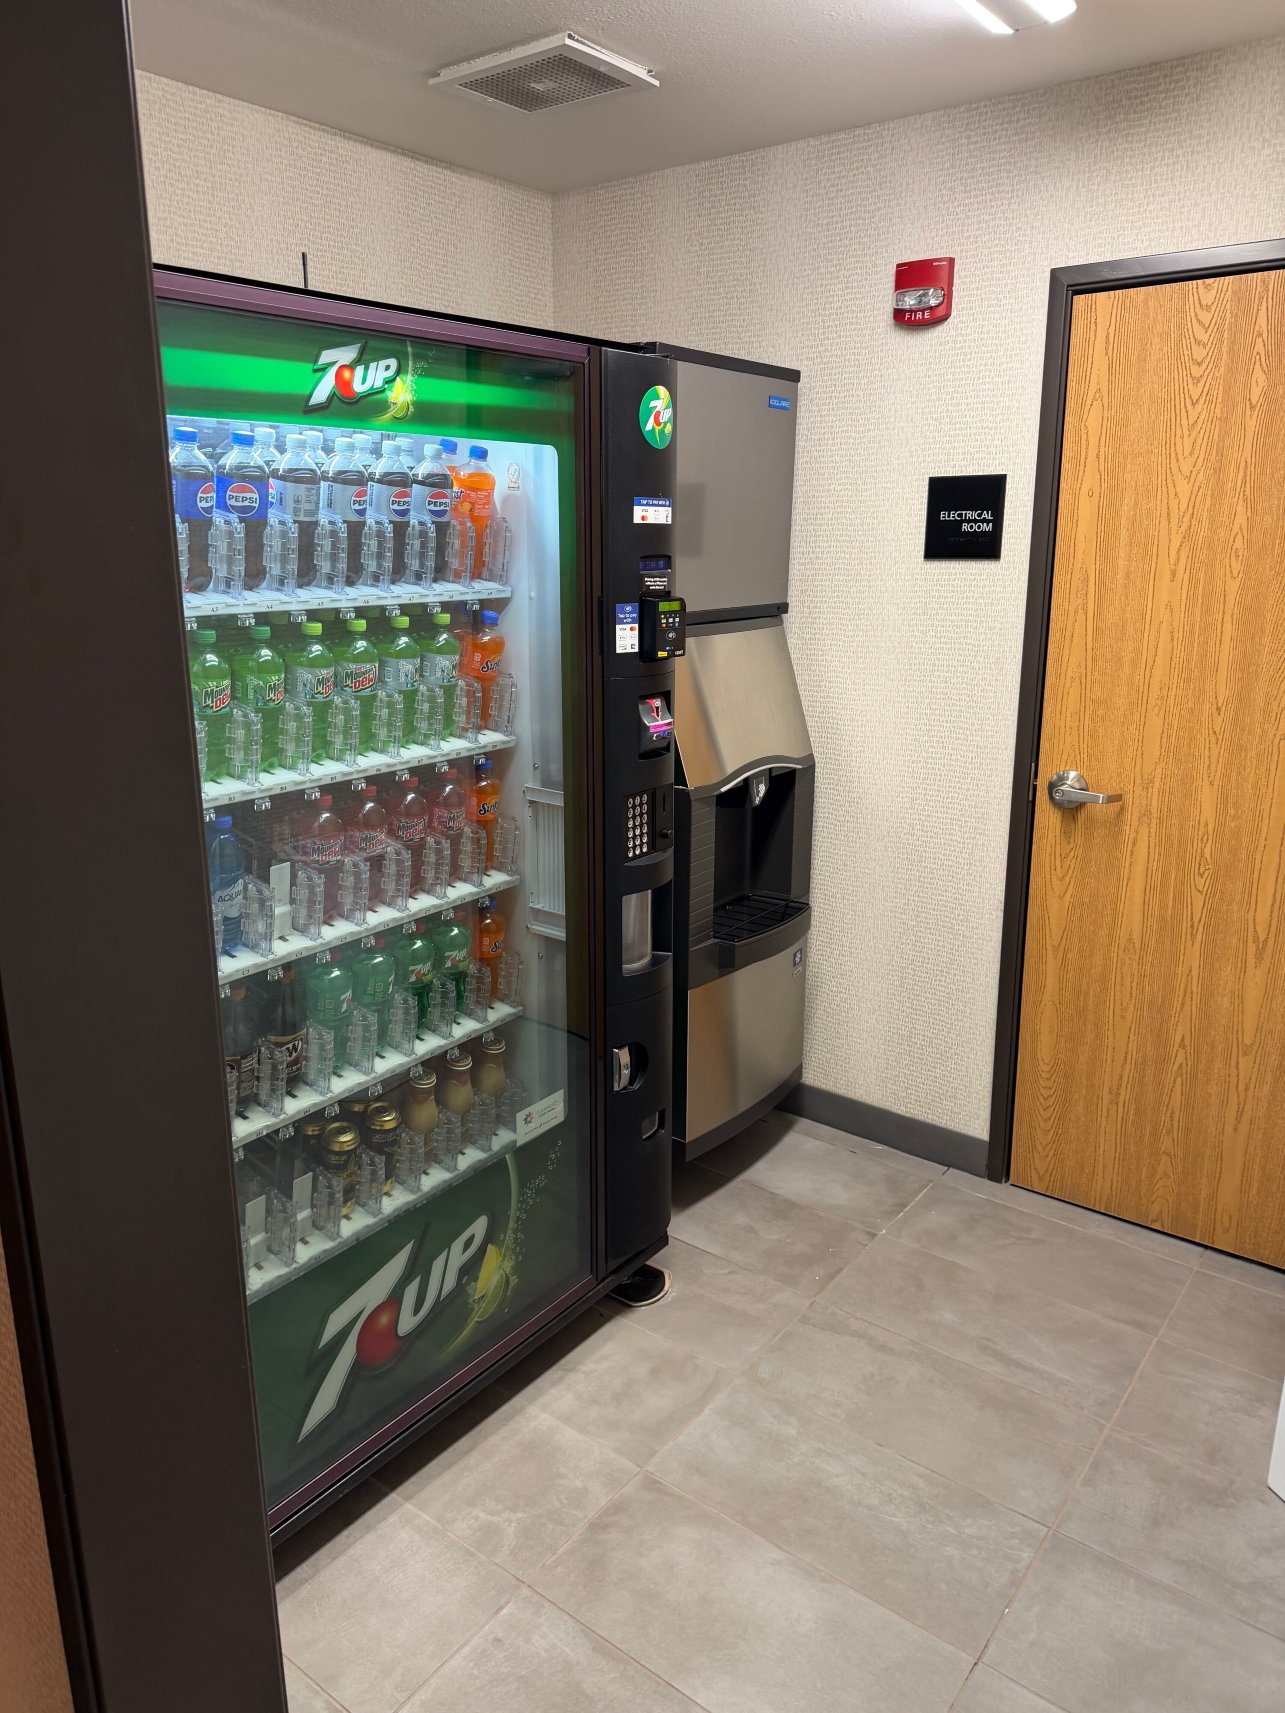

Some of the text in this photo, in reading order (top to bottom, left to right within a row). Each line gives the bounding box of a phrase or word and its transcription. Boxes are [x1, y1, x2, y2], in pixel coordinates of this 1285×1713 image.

[905, 310, 931, 321] FIRE
[308, 343, 398, 406] 7UP
[644, 398, 672, 431] 7UP
[199, 495, 214, 504] PEP
[227, 494, 258, 505] PEPSI
[391, 499, 411, 508] PEPS
[940, 510, 994, 521] ELECTRICAL
[961, 522, 993, 532] ROOM
[297, 1215, 488, 1443] 7UP
